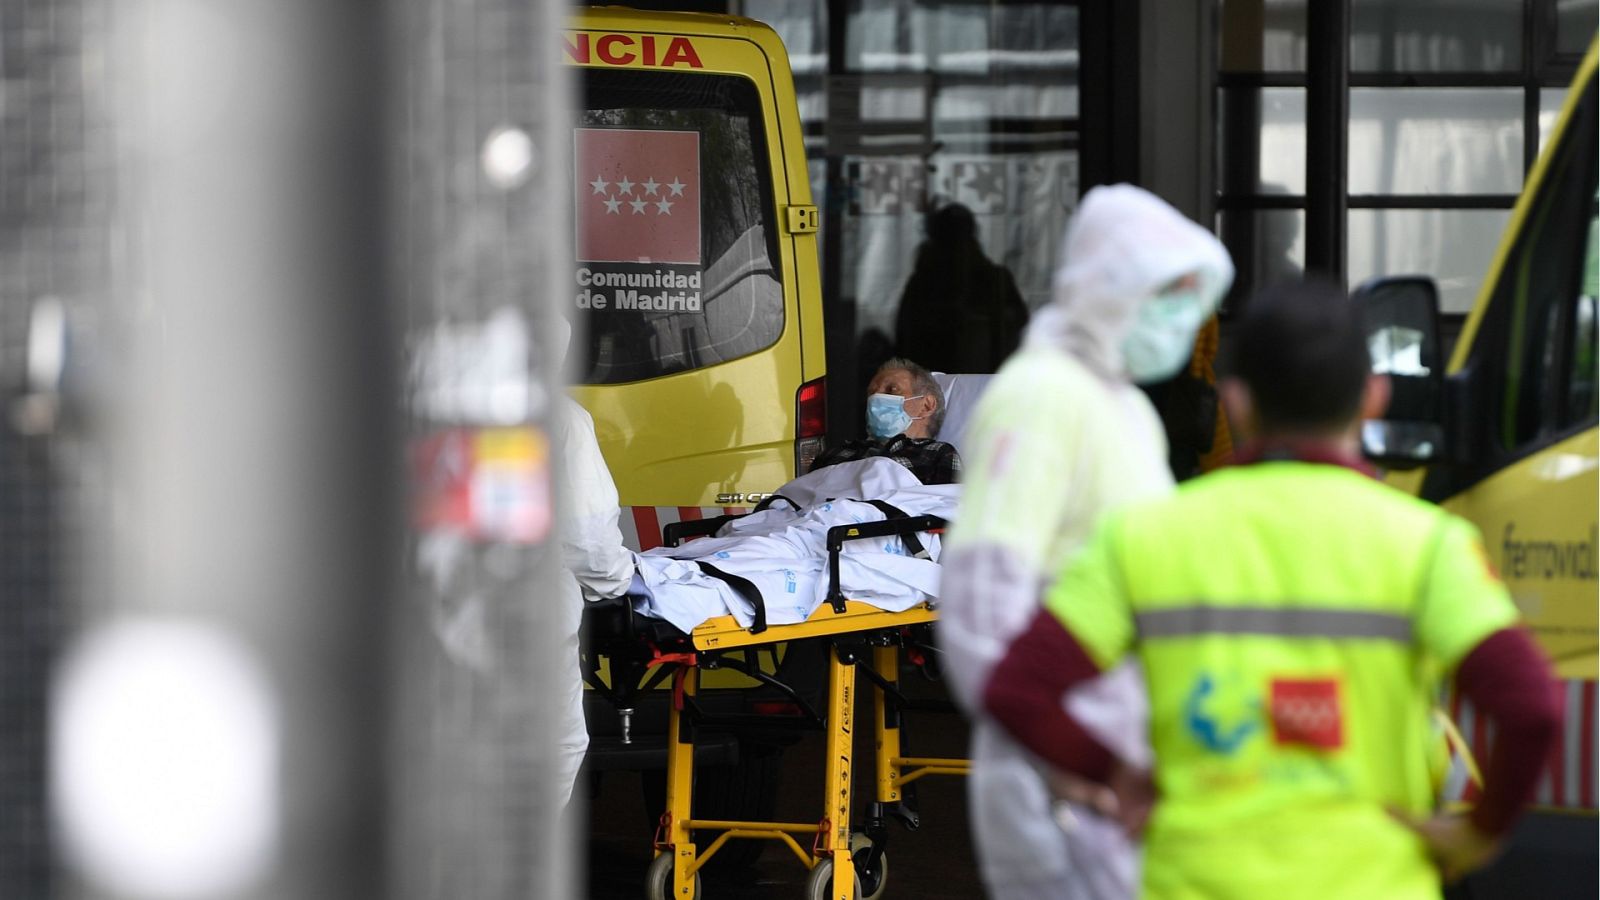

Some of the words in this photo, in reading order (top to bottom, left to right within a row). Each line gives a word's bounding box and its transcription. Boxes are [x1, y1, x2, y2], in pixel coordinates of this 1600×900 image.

[576, 267, 701, 289] Comunidad
[576, 289, 607, 310] de
[615, 289, 701, 311] Madrid
